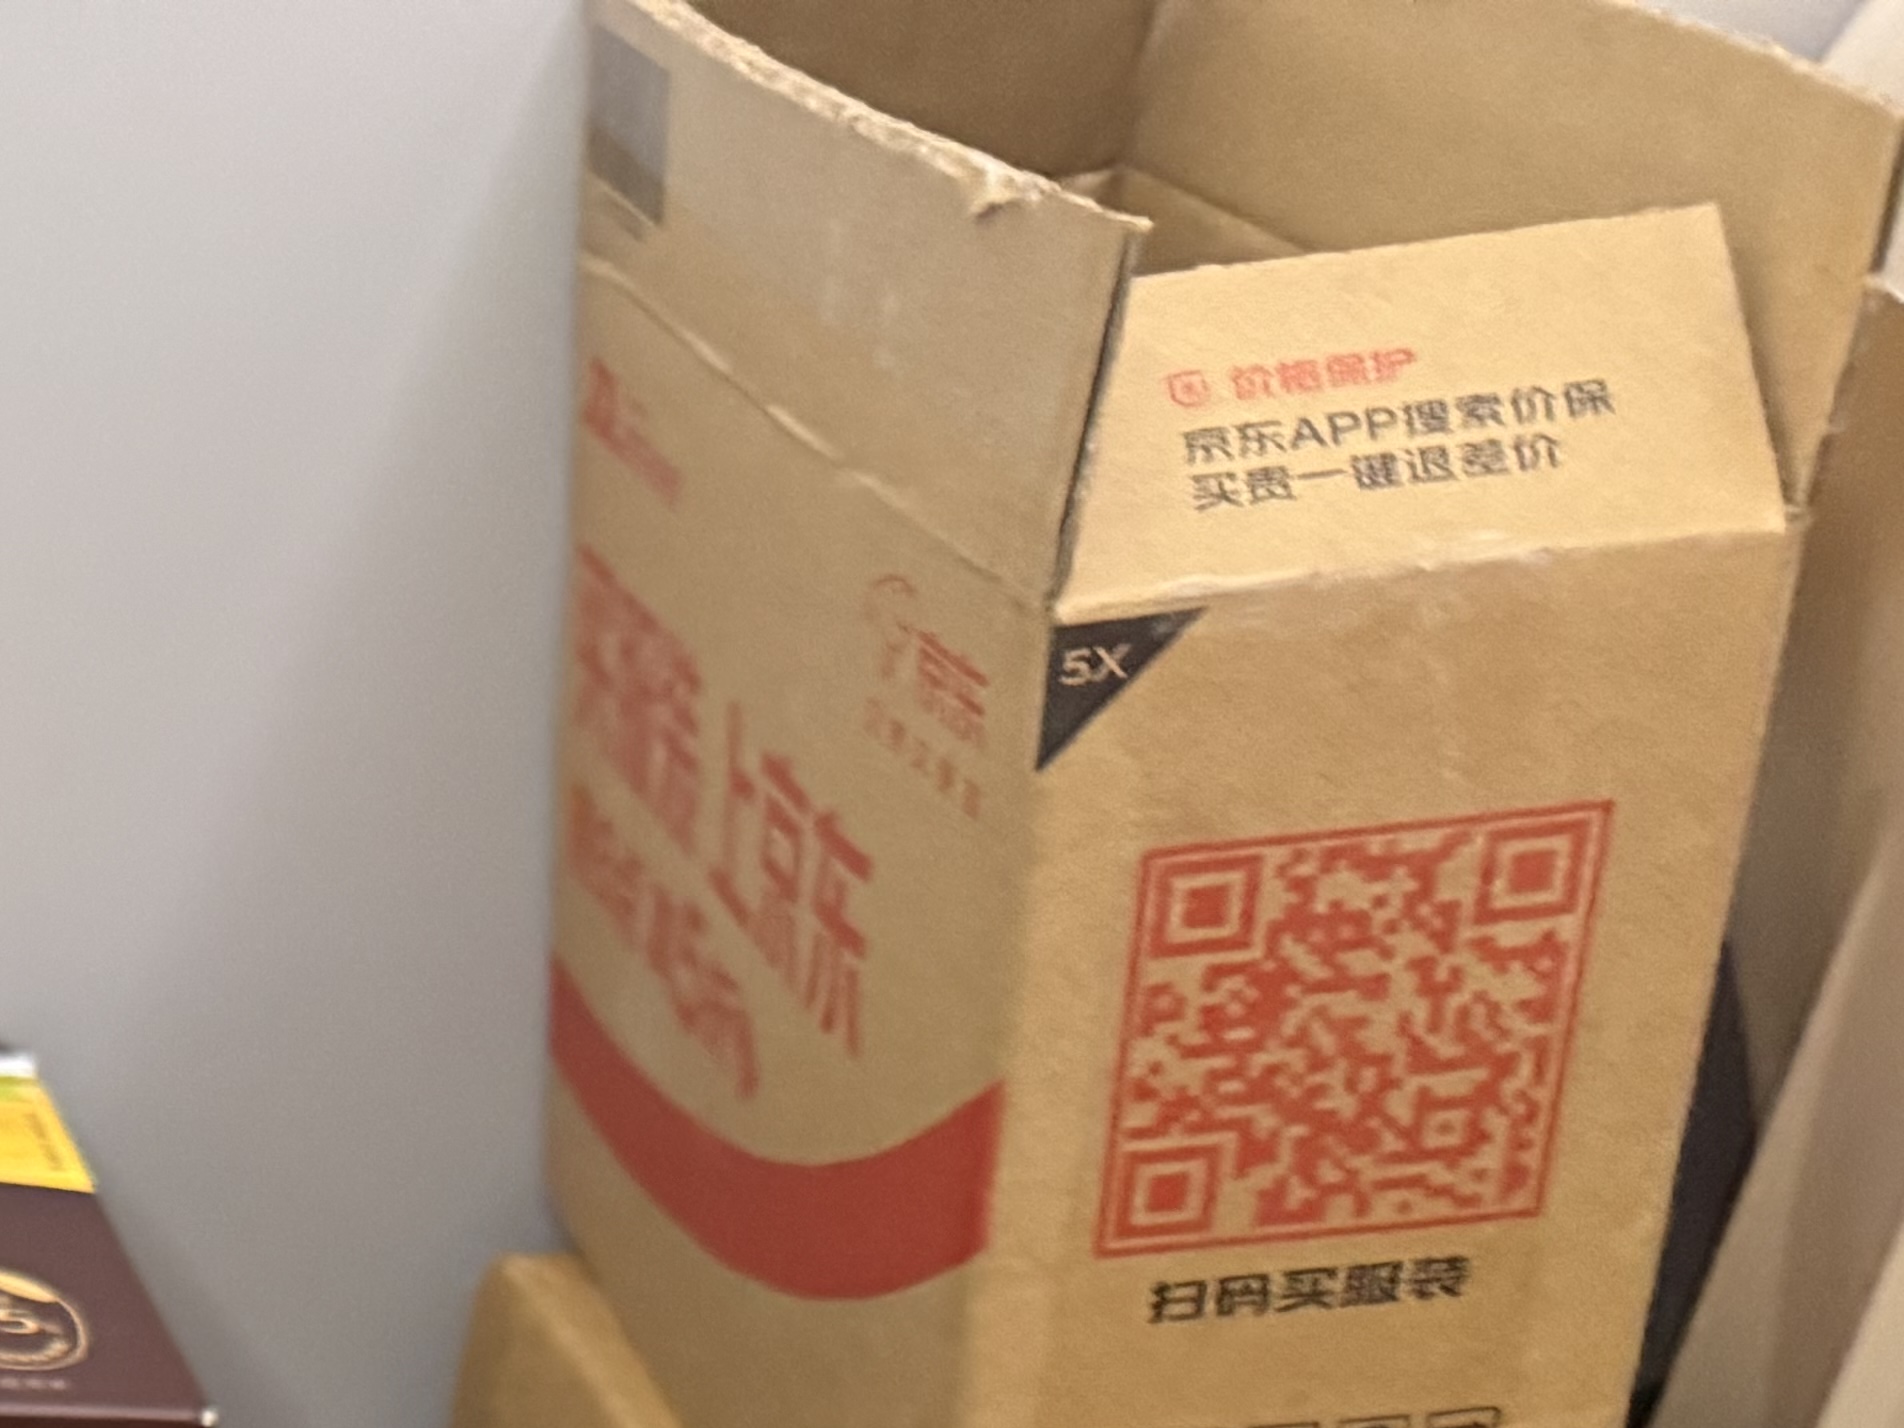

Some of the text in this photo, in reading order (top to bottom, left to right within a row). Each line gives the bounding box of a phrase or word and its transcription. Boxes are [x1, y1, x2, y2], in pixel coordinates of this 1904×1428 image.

[1229, 348, 1416, 401] 价格保护
[1184, 378, 1616, 465] 京东APP搜索价保
[1192, 433, 1561, 512] 买贵一键退差价
[1058, 643, 1132, 690] 5X
[1147, 1255, 1470, 1323] 扫码买服装
